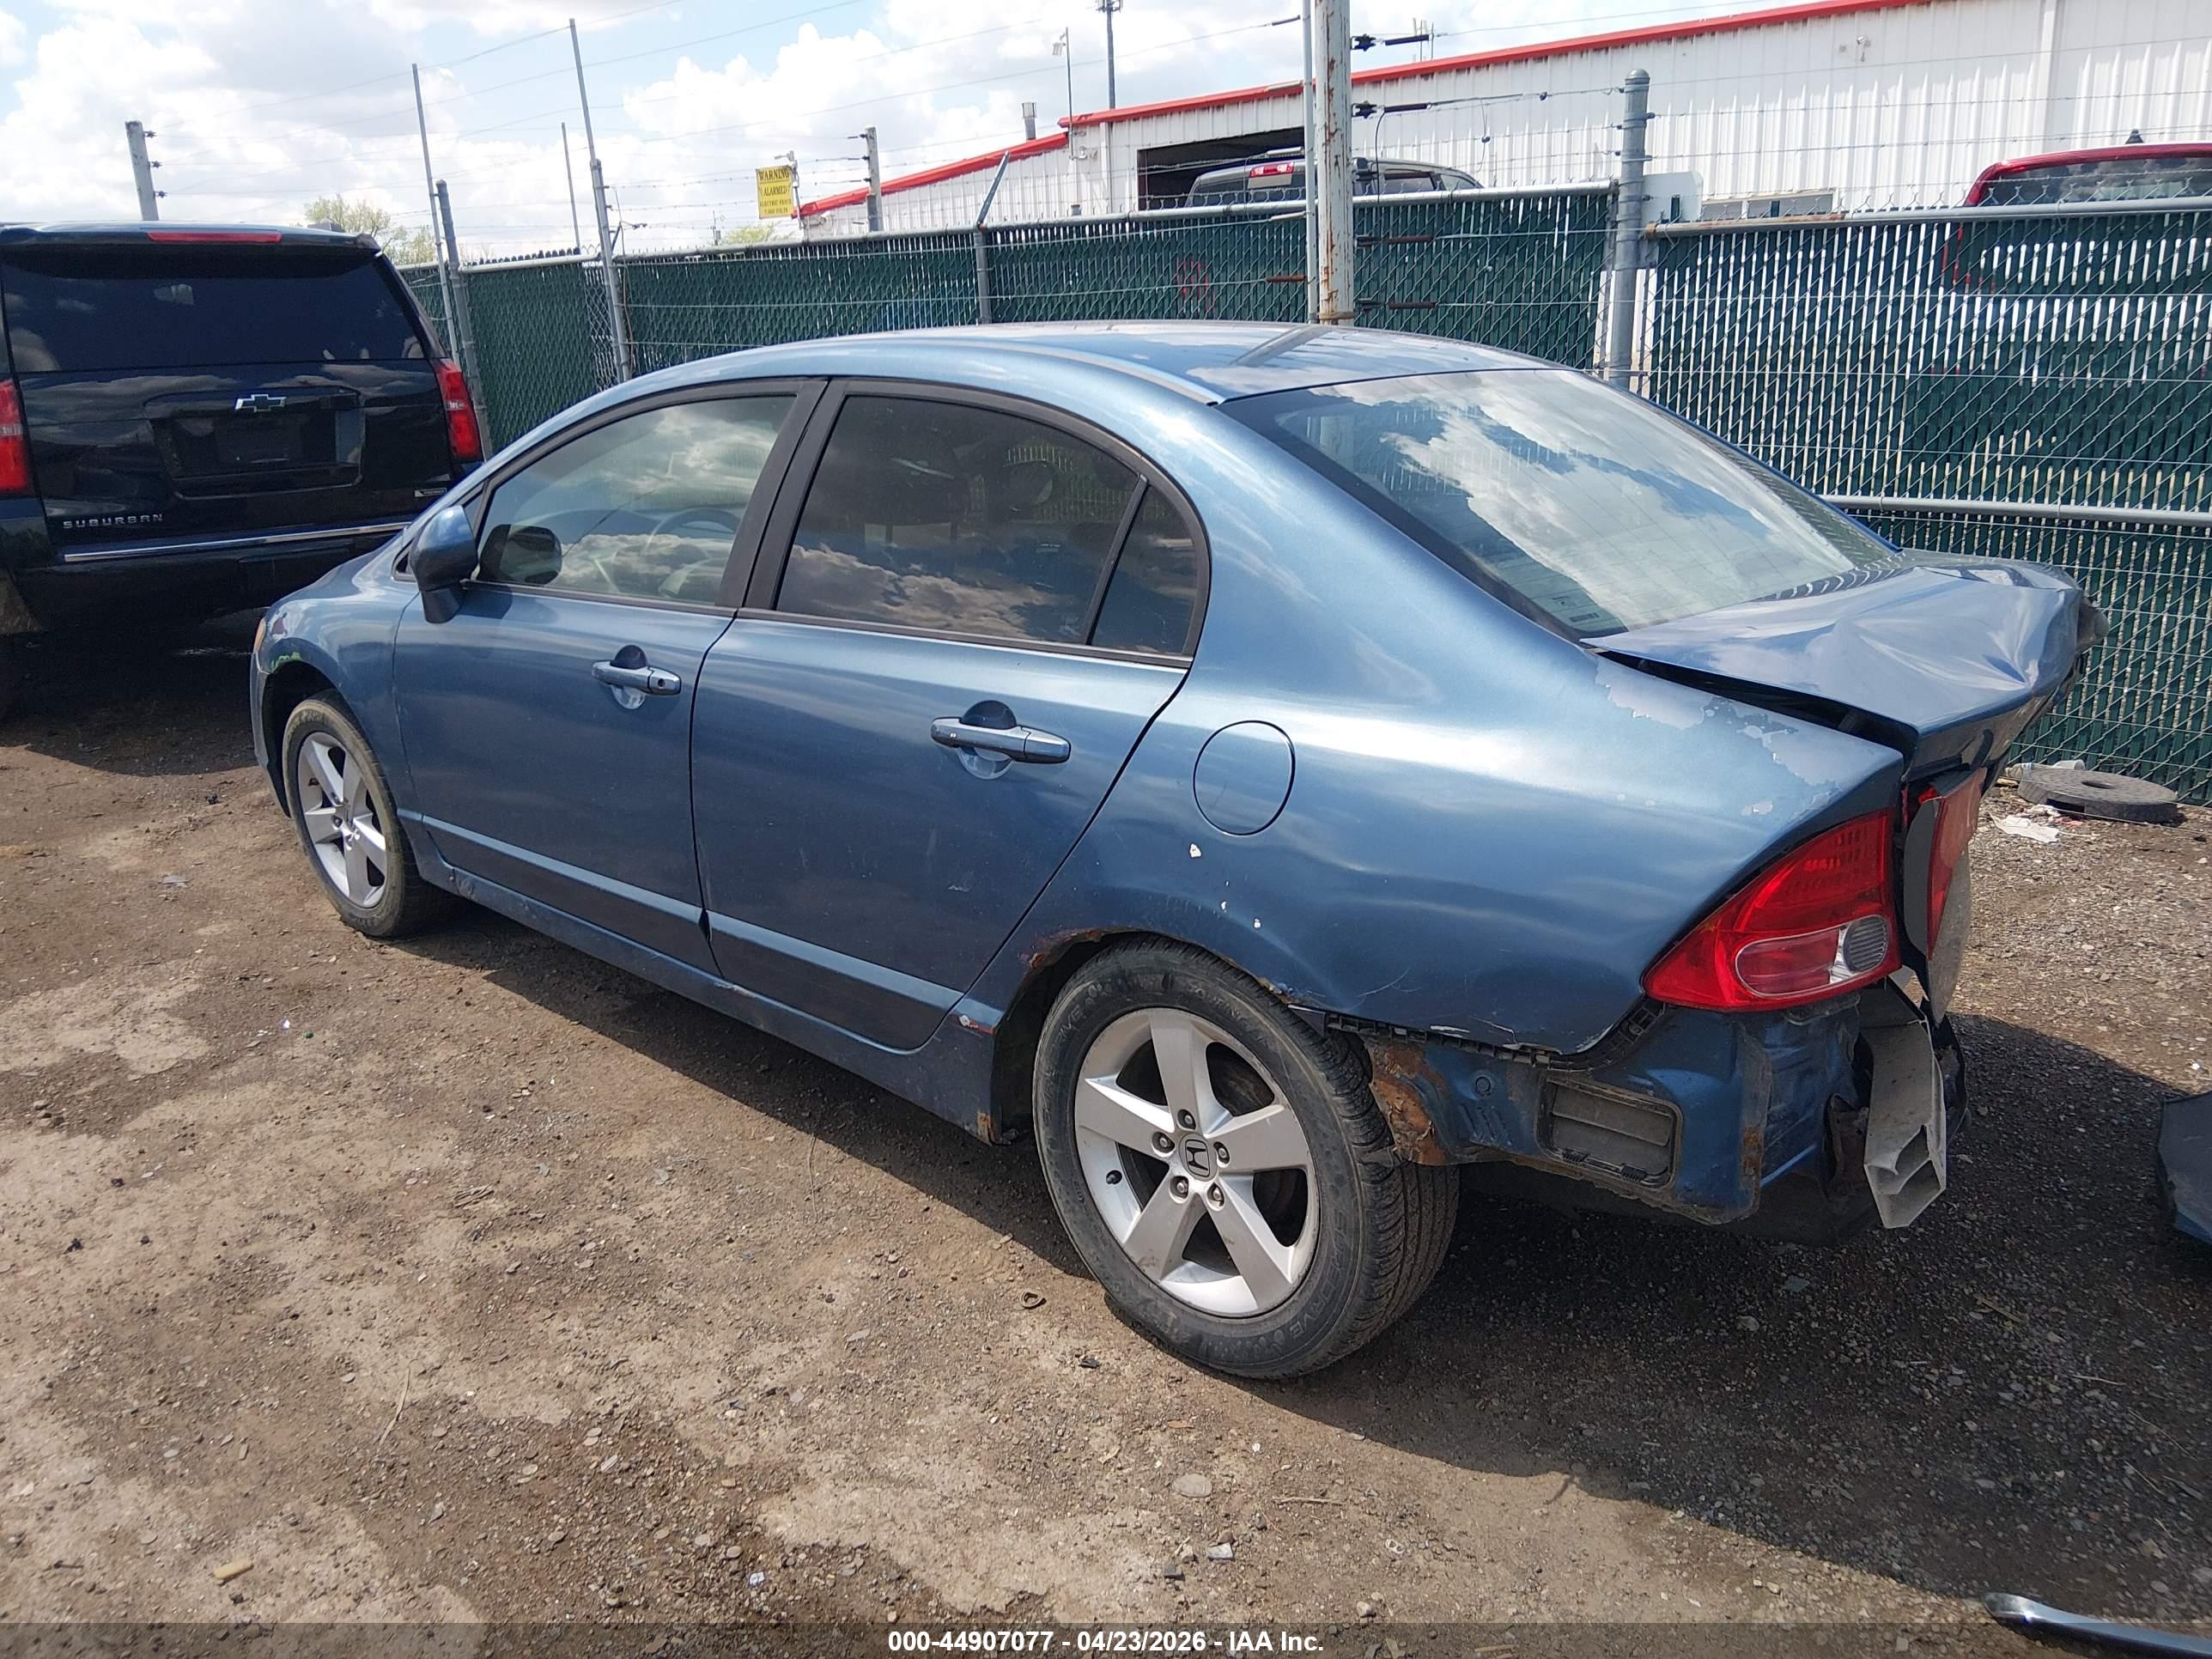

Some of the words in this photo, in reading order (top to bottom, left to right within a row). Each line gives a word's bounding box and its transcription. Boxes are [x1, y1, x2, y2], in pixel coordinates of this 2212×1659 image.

[759, 168, 789, 181] WARNING
[763, 185, 787, 196] ALARMED
[63, 514, 163, 529] SUBURBAN
